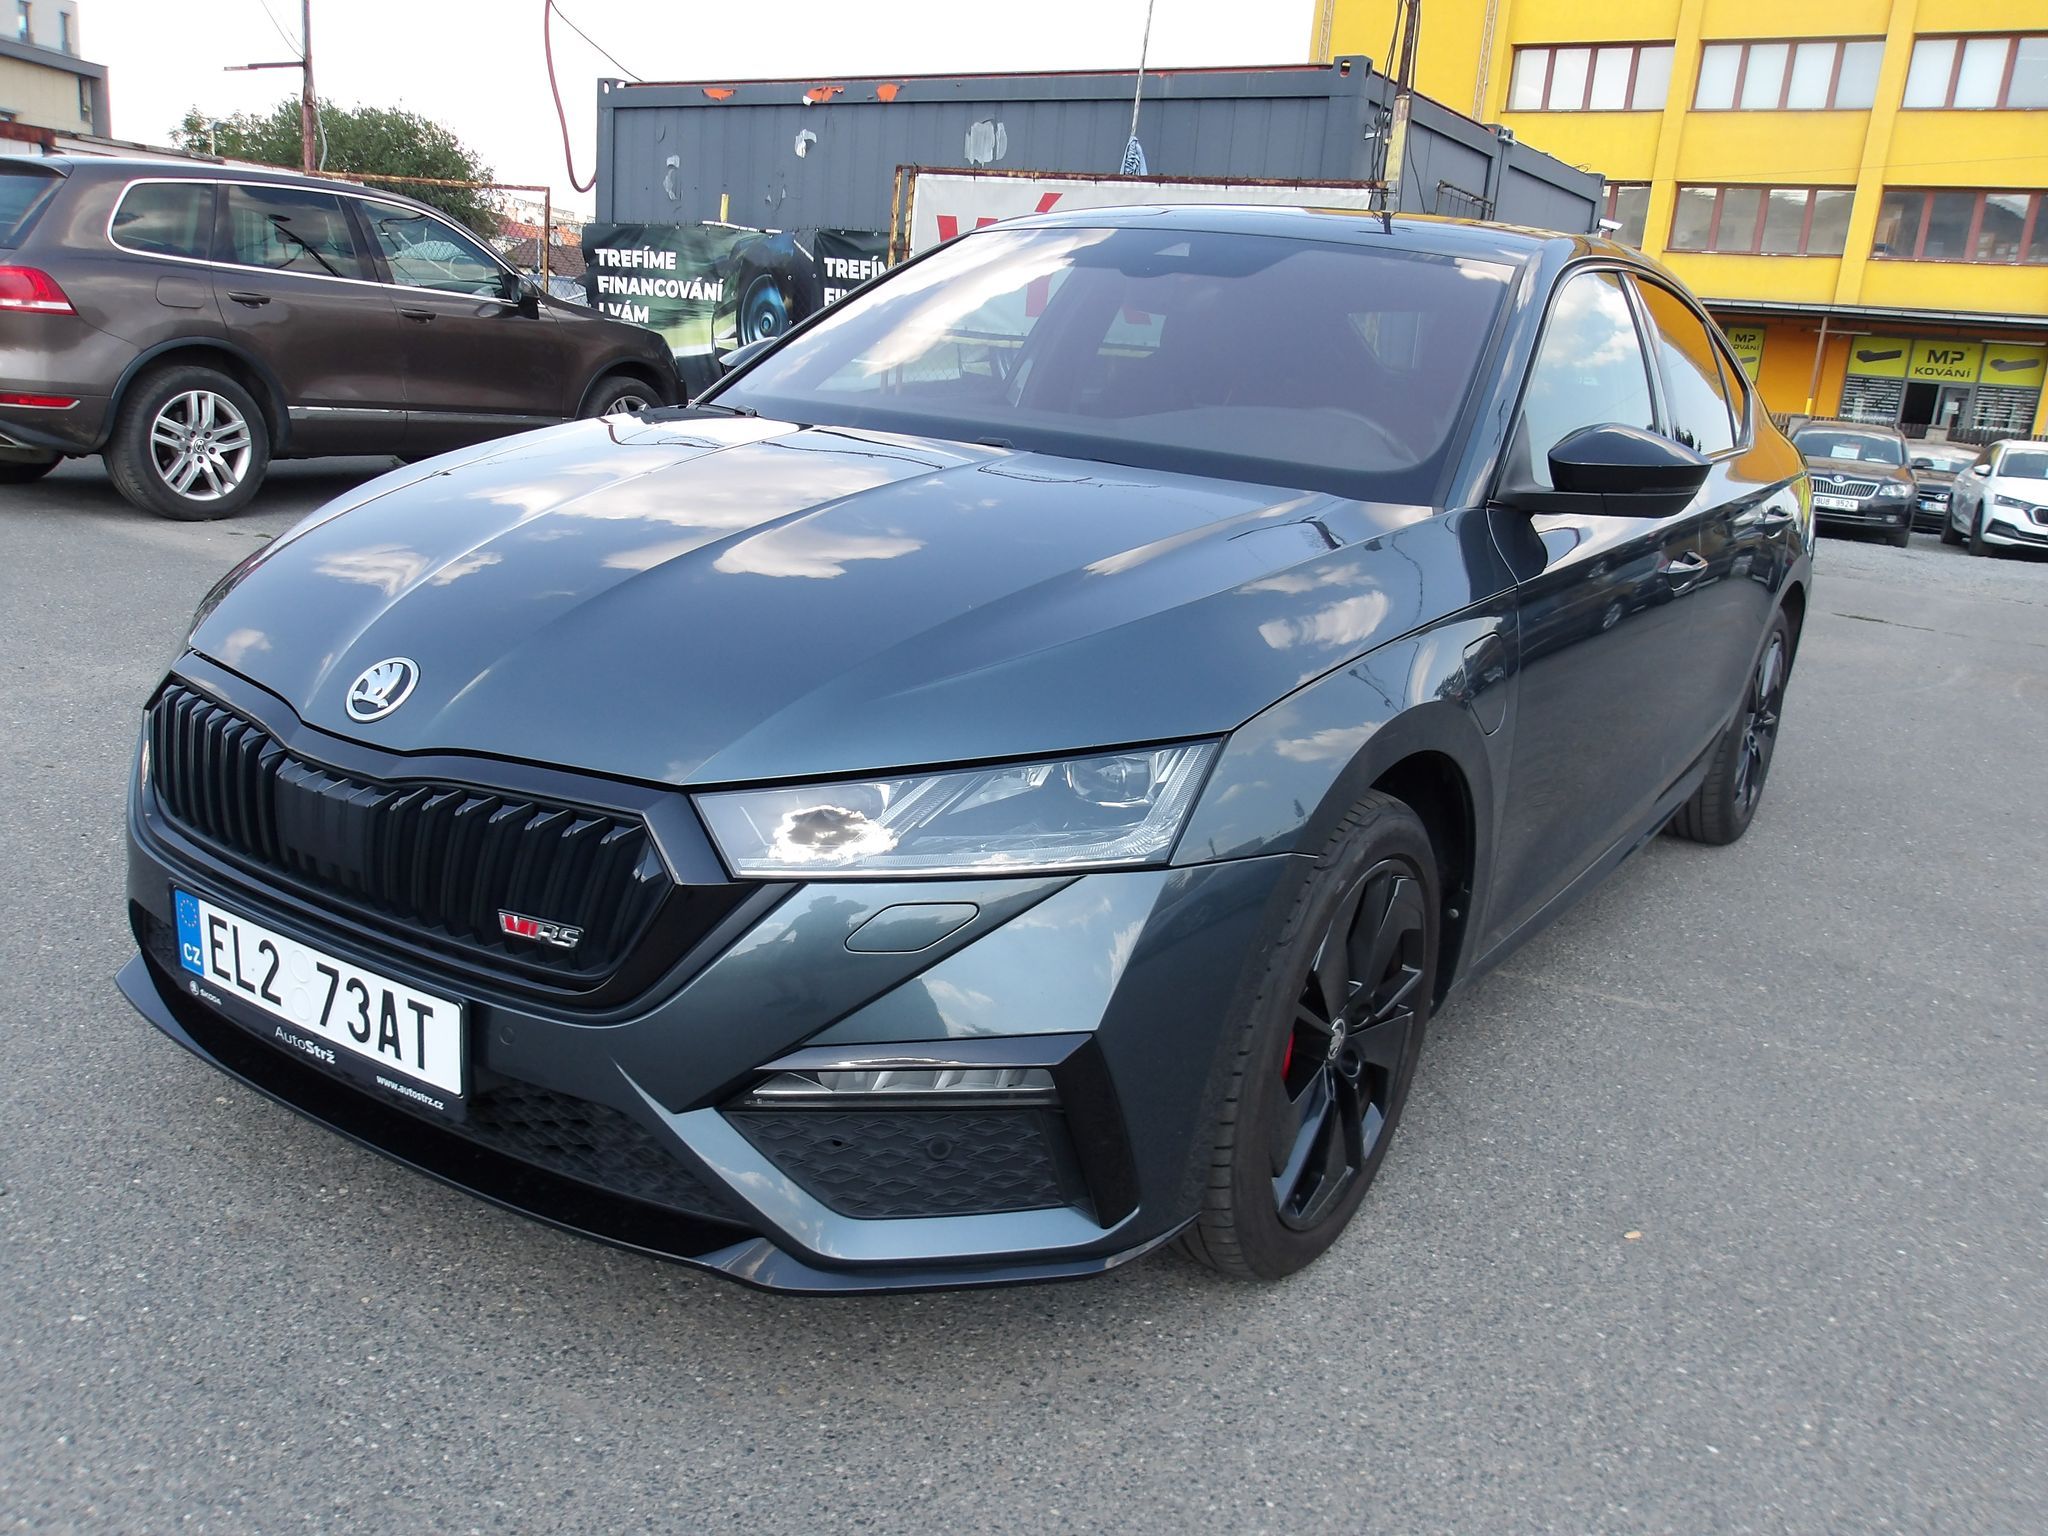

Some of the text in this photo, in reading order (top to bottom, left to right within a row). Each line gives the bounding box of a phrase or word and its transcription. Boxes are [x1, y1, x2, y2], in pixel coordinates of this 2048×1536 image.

[594, 245, 677, 270] TREFÍME
[823, 255, 902, 280] TREFÍ
[597, 276, 724, 302] FINANCOVÁNÍ
[608, 299, 650, 324] VÁM
[1734, 333, 1756, 343] MP
[1926, 349, 1965, 365] MP
[1914, 366, 1972, 378] KOVÁNÍ
[183, 942, 201, 966] CZ
[208, 913, 434, 1070] EL2 73AT
[275, 1026, 336, 1064] AutoStrž
[376, 1075, 444, 1110] www.autostrz.cz
